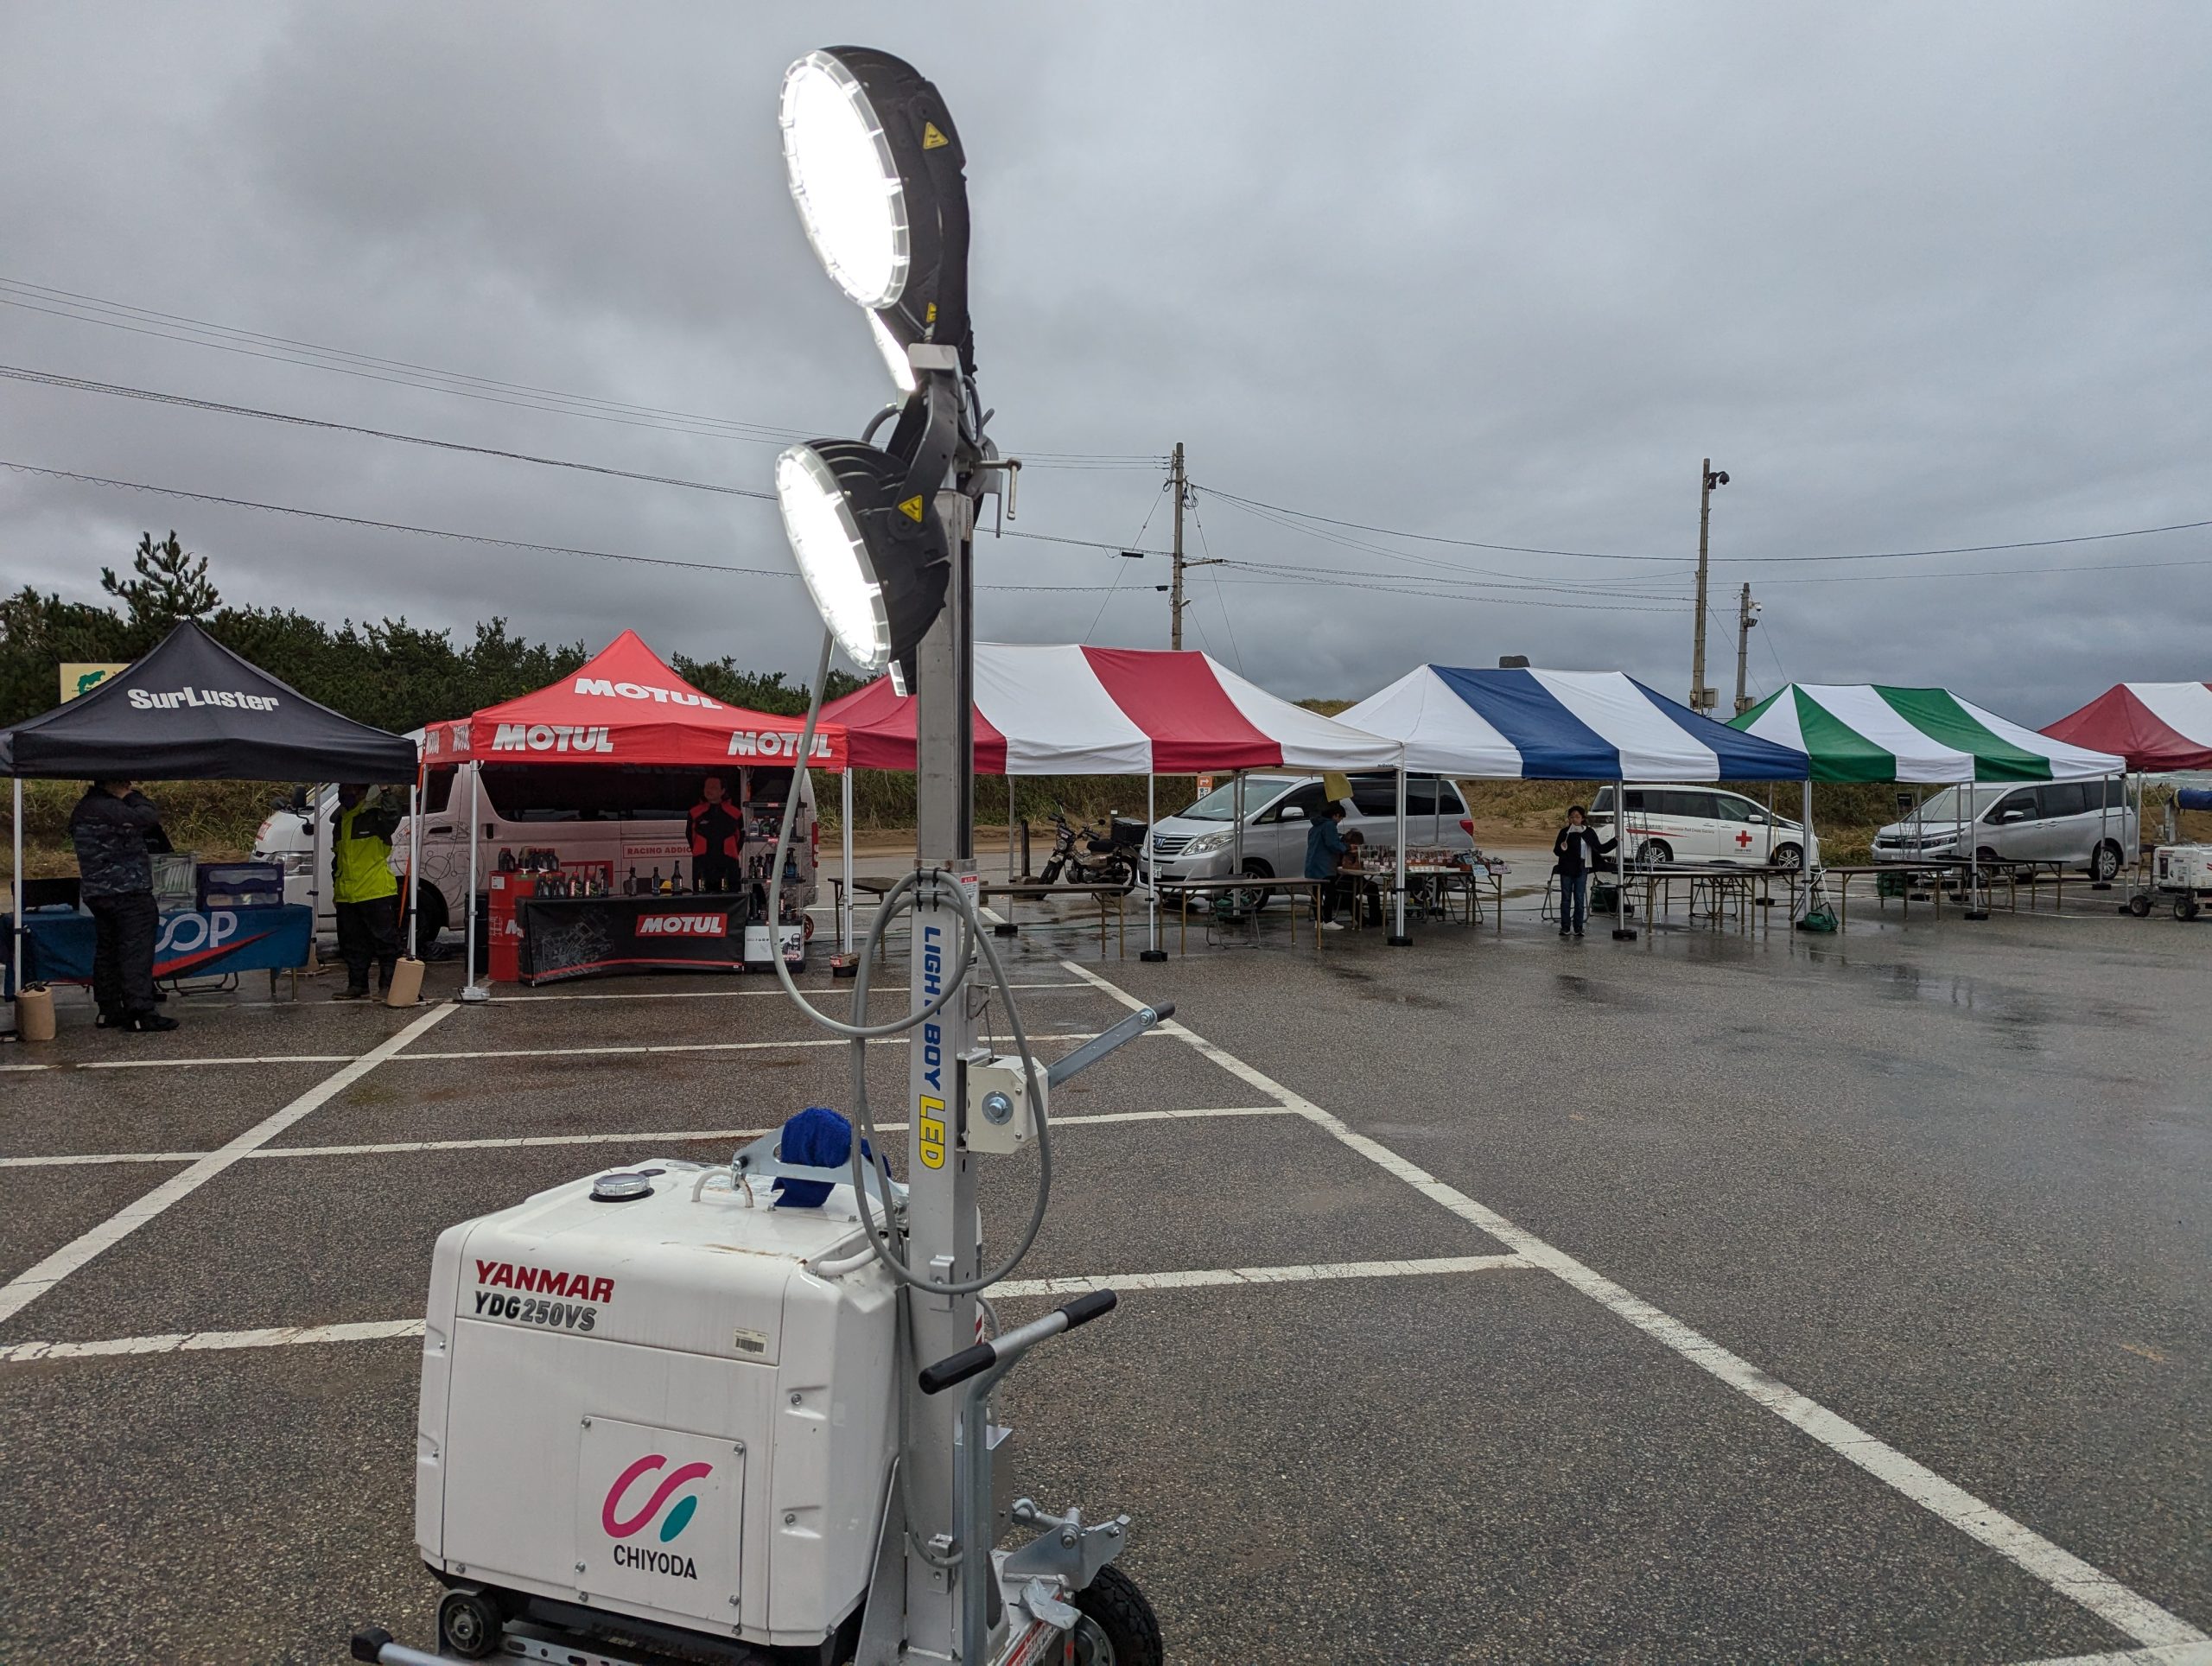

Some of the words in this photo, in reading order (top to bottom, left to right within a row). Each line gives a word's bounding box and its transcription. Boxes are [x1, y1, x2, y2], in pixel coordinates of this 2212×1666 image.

[128, 687, 279, 711] SurLuster
[574, 677, 723, 709] MOTUL
[491, 723, 614, 753] MOTUL
[728, 731, 833, 758] MOTUL
[626, 847, 663, 855] RACING
[664, 846, 693, 855] ADDIC
[639, 916, 723, 933] MOTUL
[924, 1024, 942, 1091] BOY
[918, 1093, 946, 1170] LED
[474, 1258, 616, 1304] YANMAR
[474, 1290, 598, 1332] YDG250VS
[613, 1544, 698, 1580] CHIYODA
